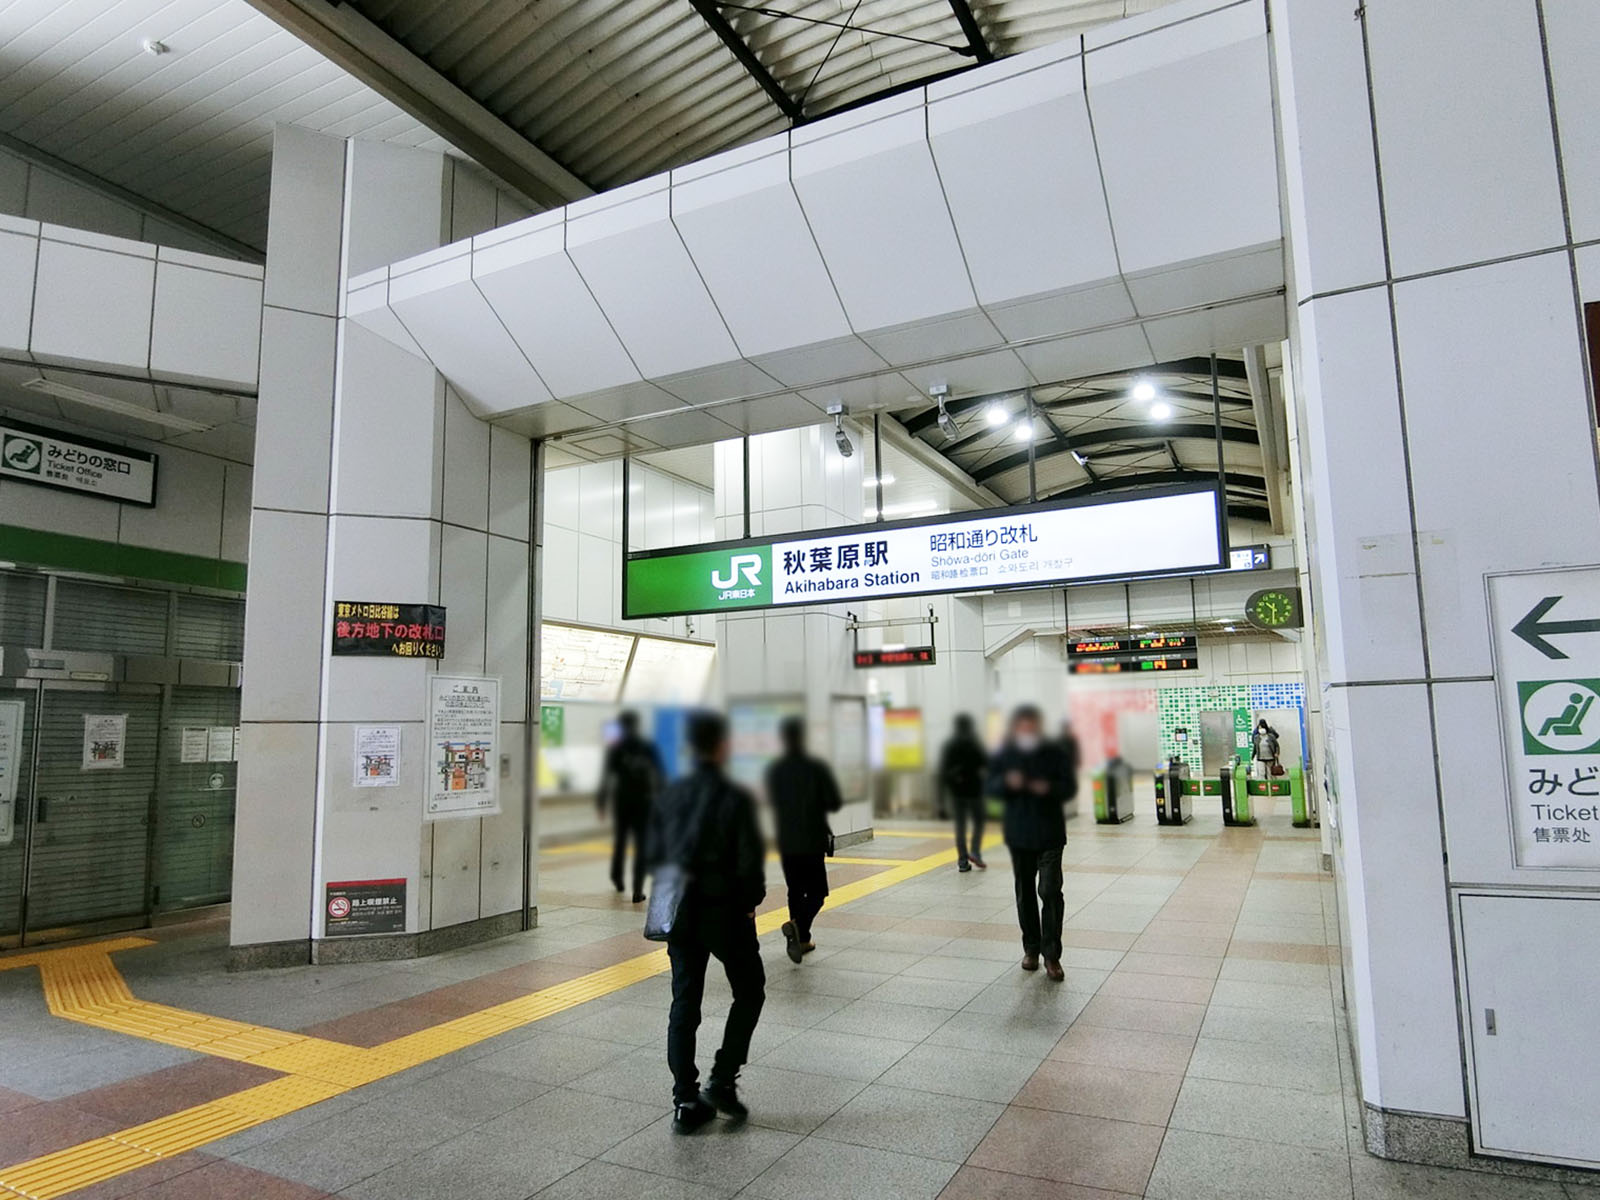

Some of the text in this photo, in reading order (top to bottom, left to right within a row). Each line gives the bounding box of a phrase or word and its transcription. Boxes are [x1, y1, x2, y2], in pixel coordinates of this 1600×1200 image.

[47, 444, 131, 475] みどりの窓口
[47, 460, 103, 479] Ticket Office
[929, 523, 1038, 553] 昭和通り改札
[783, 540, 889, 576] 秋葉原駅
[999, 548, 1029, 561] Gate
[711, 553, 762, 590] JR
[784, 570, 921, 595] Akihabara Station
[336, 620, 445, 641] 後方地下の改札口
[1528, 766, 1600, 796] みど
[1530, 804, 1599, 821] Ticket
[1532, 826, 1591, 843] 售票处
